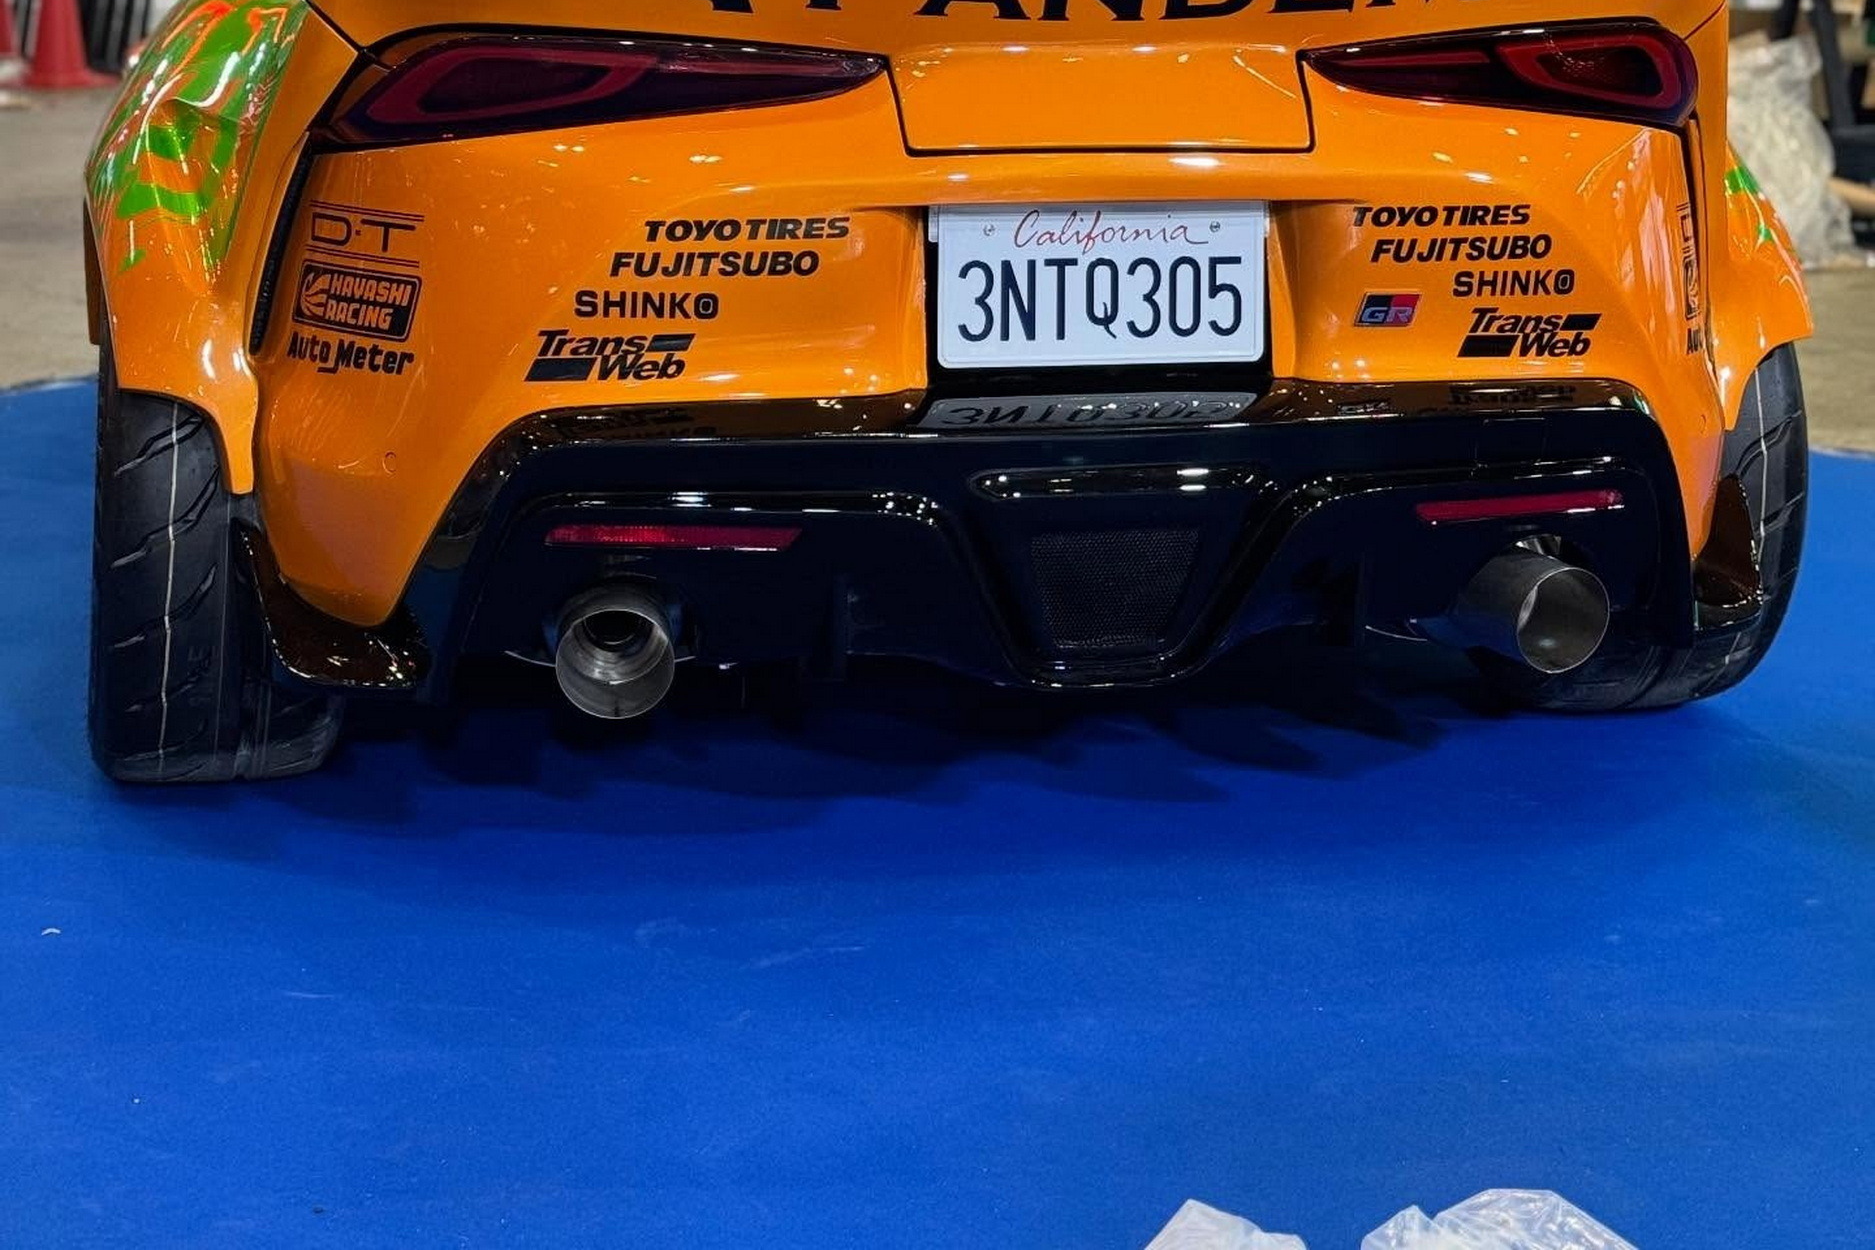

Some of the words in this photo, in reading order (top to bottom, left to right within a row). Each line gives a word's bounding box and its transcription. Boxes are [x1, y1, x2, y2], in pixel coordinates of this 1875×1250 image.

[643, 220, 744, 242] TOYO
[746, 216, 851, 240] TIRES
[1352, 206, 1438, 229] TOYO
[1442, 203, 1532, 227] TIRES
[1013, 209, 1210, 256] California
[1370, 233, 1553, 264] FUJITSUBO
[609, 250, 821, 279] FUJITSUBO
[1452, 268, 1576, 298] SHINKO
[573, 290, 720, 321] SHINKO
[958, 255, 1243, 343] 3NTQ305
[324, 299, 394, 331] RACING
[1361, 306, 1414, 323] GR
[1470, 307, 1562, 333] Trans
[287, 331, 332, 364] Auto
[317, 339, 415, 376] Meter
[537, 329, 650, 357] Trans
[1511, 331, 1592, 358] Web
[597, 353, 687, 381] Web
